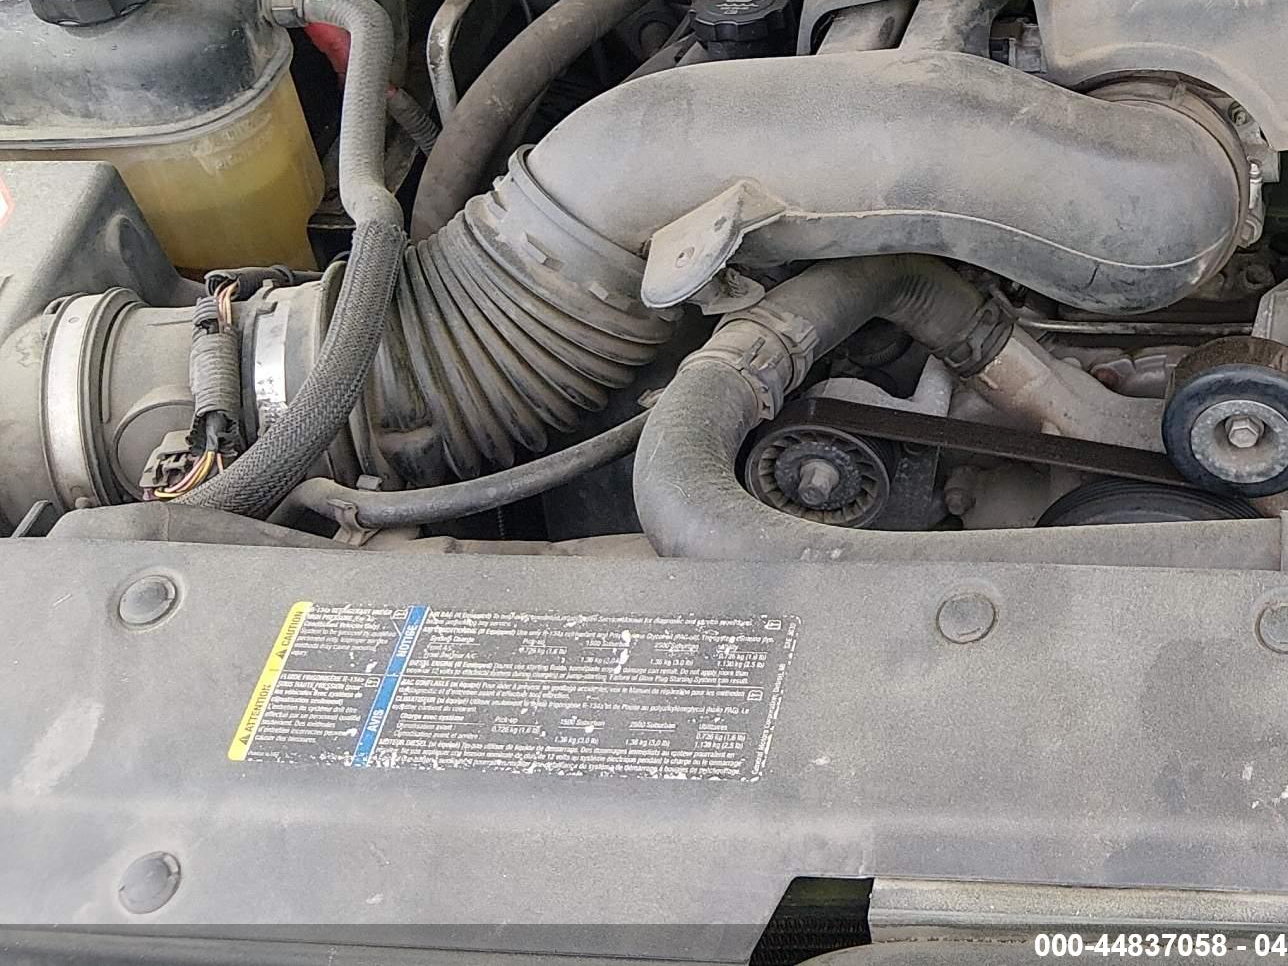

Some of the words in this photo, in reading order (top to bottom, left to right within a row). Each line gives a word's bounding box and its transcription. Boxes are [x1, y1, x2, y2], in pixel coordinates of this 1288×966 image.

[282, 610, 304, 647] CAUTION
[397, 624, 418, 658] NOTICE
[244, 684, 272, 733] ATTENTION
[367, 708, 385, 733] AVIS
